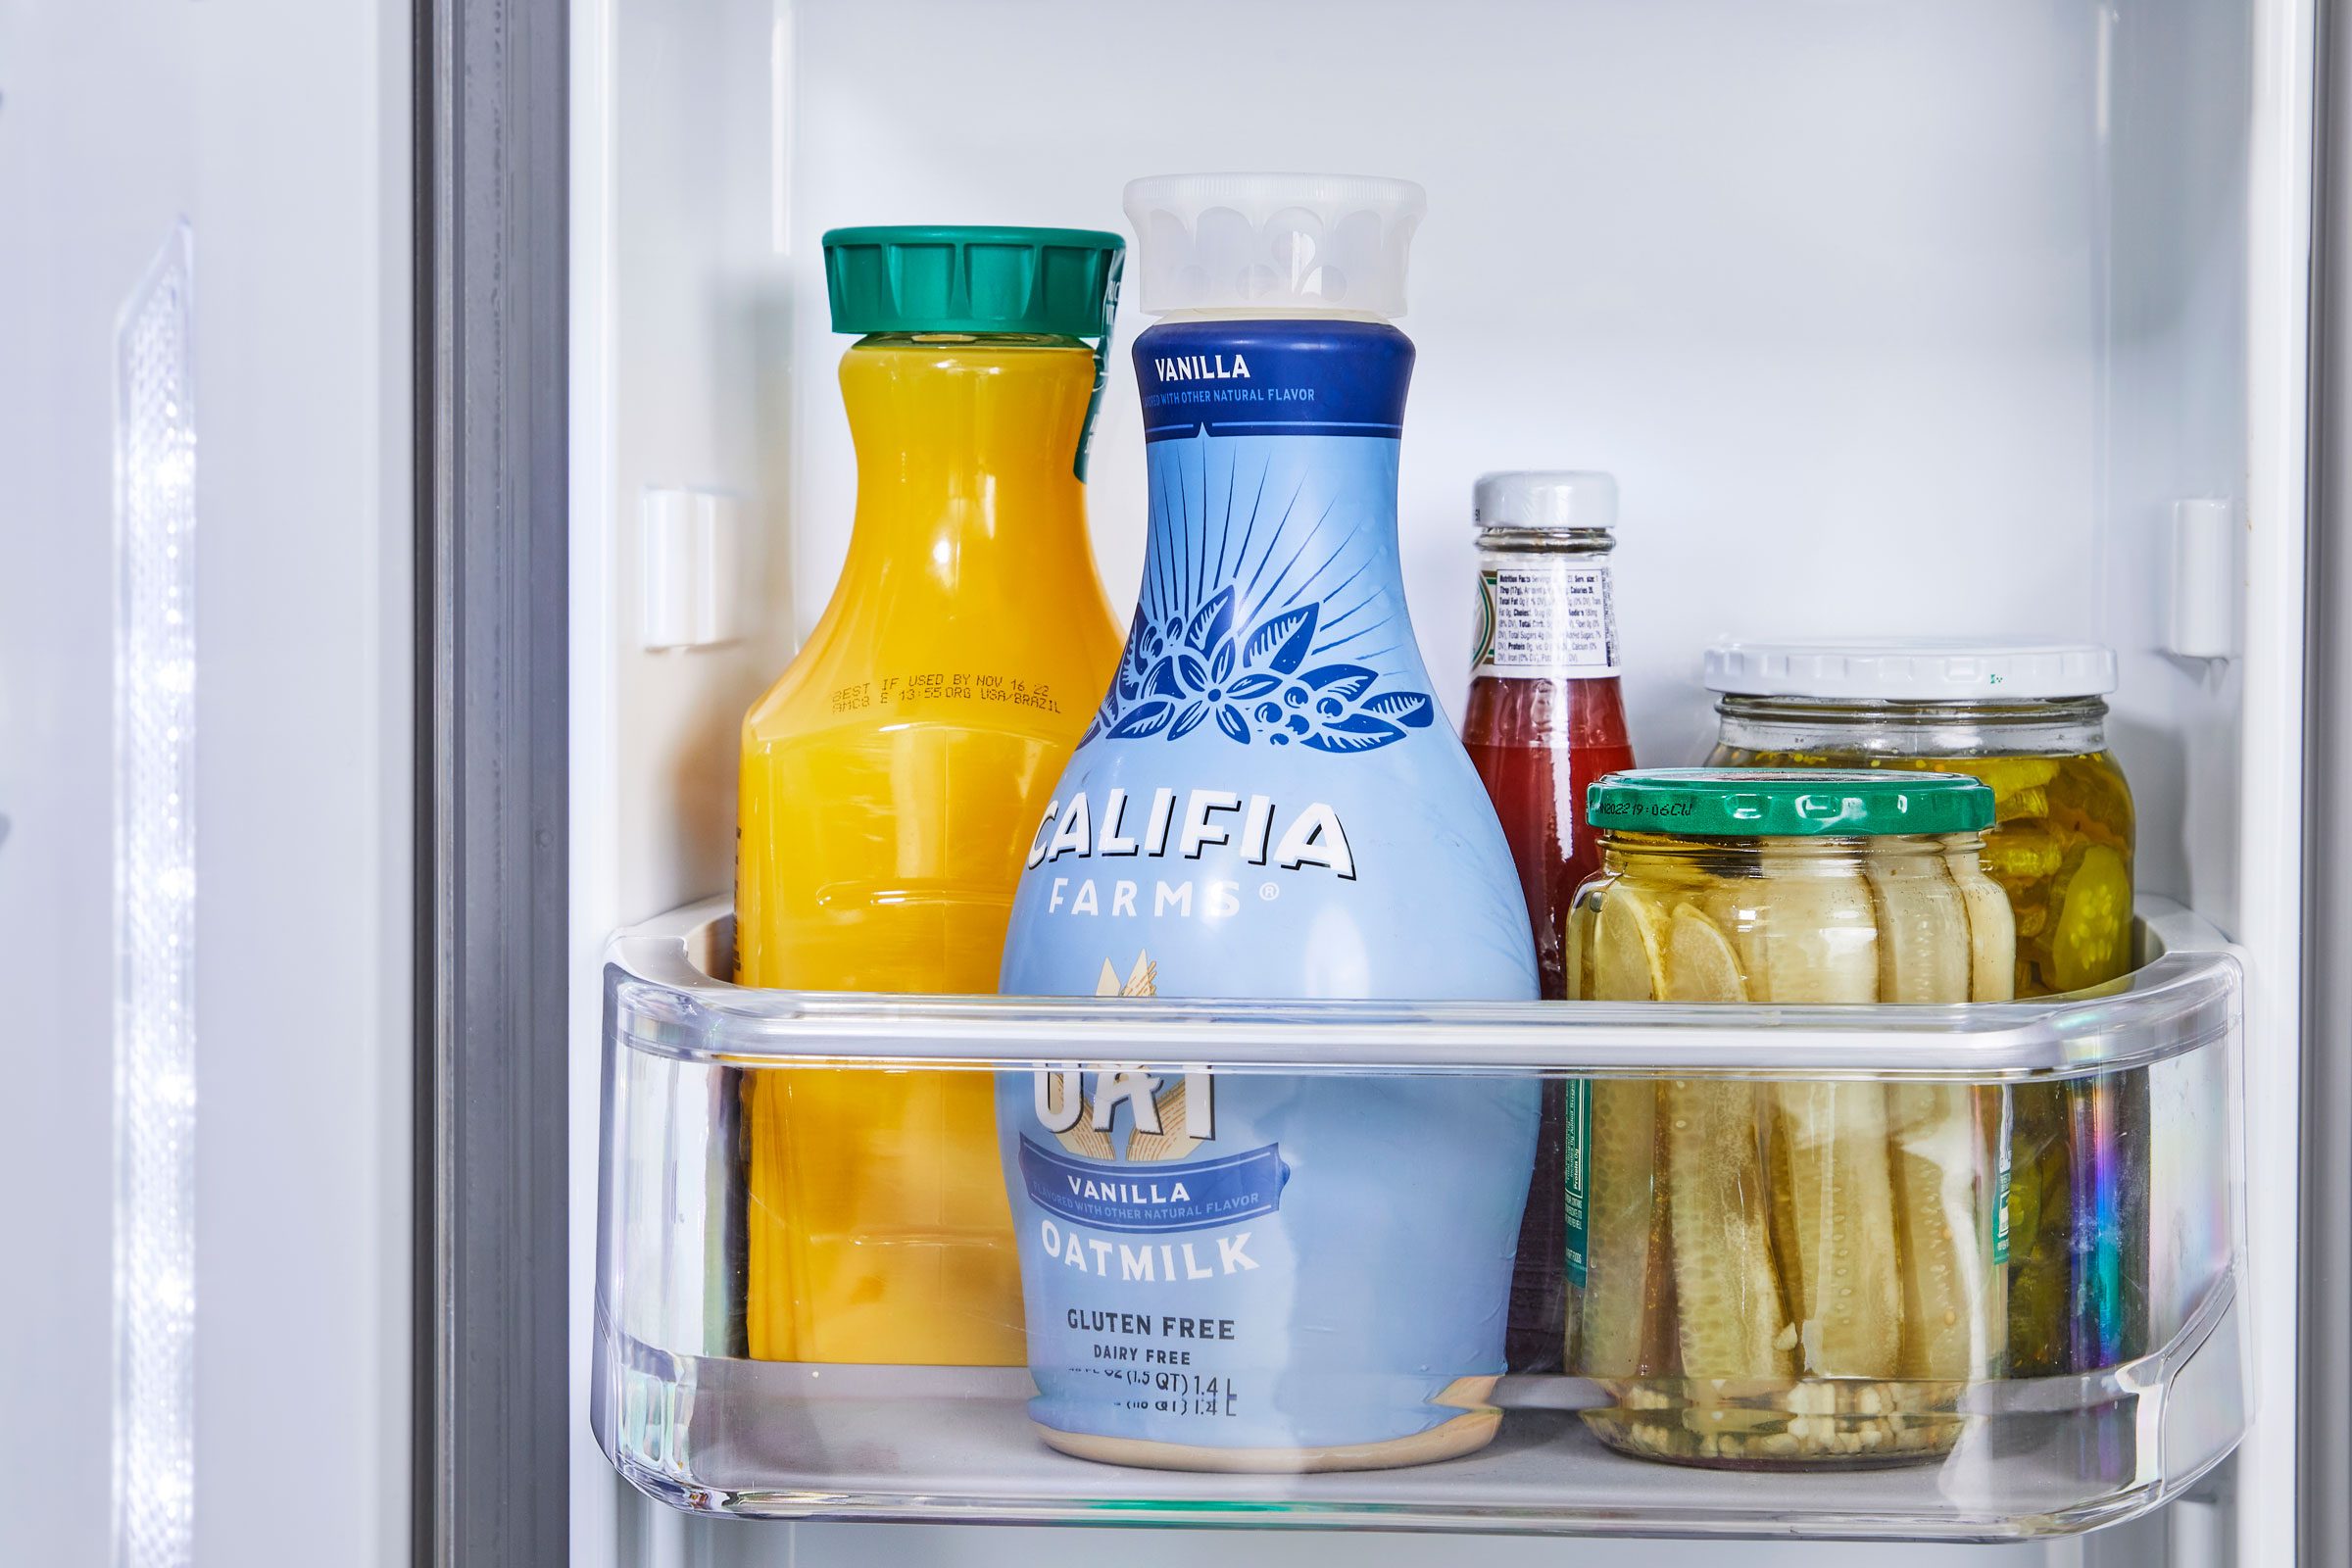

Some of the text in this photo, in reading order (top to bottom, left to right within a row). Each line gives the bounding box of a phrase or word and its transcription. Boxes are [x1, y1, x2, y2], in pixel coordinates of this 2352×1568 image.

[1155, 354, 1250, 382] VANILLA
[1161, 392, 1180, 405] WITH
[1181, 390, 1211, 404] OTHER
[1213, 389, 1264, 403] NATURAL
[1268, 388, 1315, 402] FLAVOR
[832, 673, 1050, 703] BEST IF USED BY NOV 16 22
[899, 687, 942, 702] 13:55
[946, 687, 971, 699] ORG
[1028, 787, 1357, 881] CALIFIA
[1049, 878, 1240, 917] FARMS
[1033, 1181, 1259, 1220] FLAVORED WITH OTHER NATURAL FLAVOR
[1067, 1174, 1191, 1204] VANILLA
[1042, 1220, 1260, 1282] OATMILK
[1067, 1309, 1235, 1340] GLUTEN FREE
[1094, 1345, 1191, 1365] DAIRY FREE
